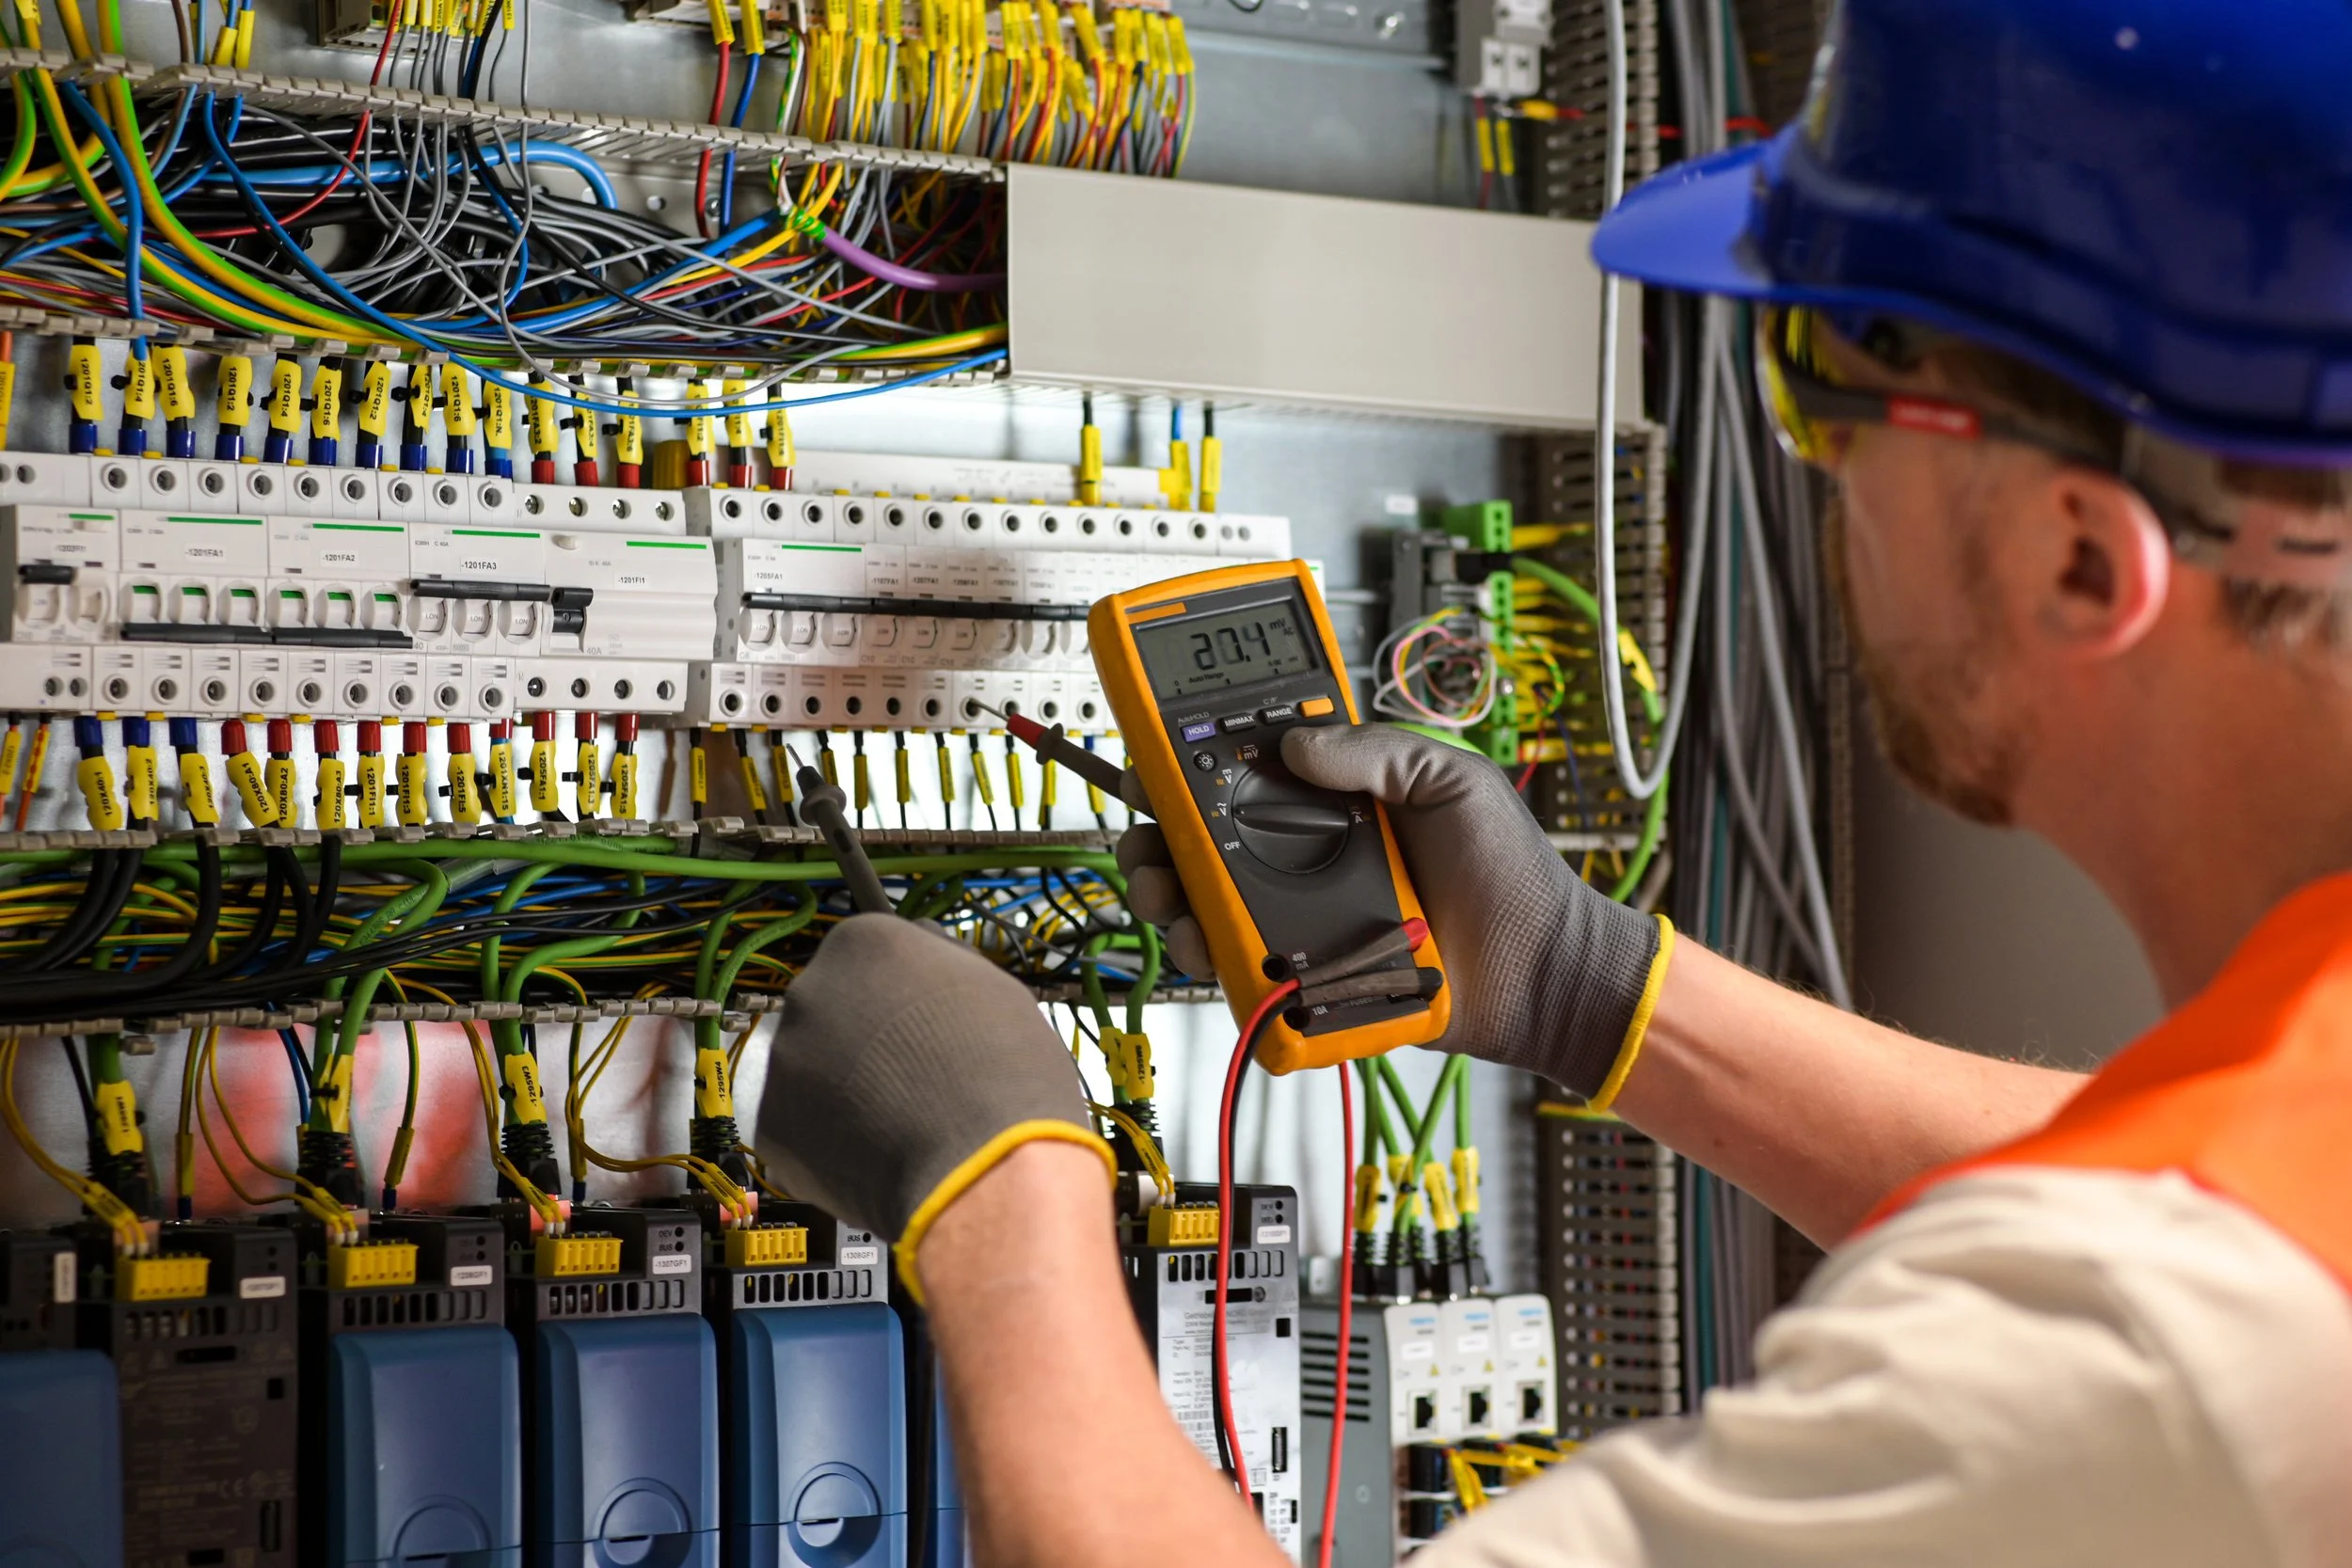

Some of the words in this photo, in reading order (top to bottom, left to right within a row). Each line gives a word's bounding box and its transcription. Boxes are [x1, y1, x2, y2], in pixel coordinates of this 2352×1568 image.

[79, 356, 95, 405] 1201Q1:2
[135, 361, 147, 403] 201Q1:4
[161, 357, 179, 406] 1201Q1:6
[226, 366, 238, 411] 1201Q1:2
[280, 372, 292, 418] 1201Q1:4
[323, 379, 332, 426] 1201Q1:6
[369, 375, 385, 420] 1201Q1:2
[451, 375, 462, 422] 1201Q1:6
[530, 396, 543, 445] 201FA3:2
[184, 548, 224, 558] -1201FA1
[322, 553, 356, 562] -1201FA2
[461, 561, 497, 570] -1201FA3
[617, 576, 645, 584] -1201FI1
[754, 572, 784, 580] -1205FA1
[586, 646, 603, 656] 40A
[1189, 621, 1271, 671] 20.4
[1269, 617, 1286, 631] mV
[1188, 725, 1210, 736] HOLD
[1224, 714, 1255, 727] MINMAX
[1265, 707, 1293, 719] RANGE
[94, 770, 114, 817] 120X40:1
[241, 761, 270, 814] 120X80:A1
[278, 767, 290, 822] 120X80:A2
[365, 767, 376, 817] 1201FI1:1
[401, 764, 411, 815] 1201FI1:3
[498, 751, 509, 812] 1201XN1:15
[537, 750, 548, 800] 1205FA1:1
[587, 753, 597, 805] 1205FA1:3
[619, 763, 629, 815] 1205FA1:5
[1224, 841, 1241, 851] OFF
[1311, 1005, 1329, 1016] 10A
[520, 1065, 538, 1107] -1295W3
[714, 1060, 726, 1103] -1295W4
[659, 1229, 674, 1238] DEV
[659, 1243, 674, 1252] BUS
[847, 1234, 862, 1243] BUS
